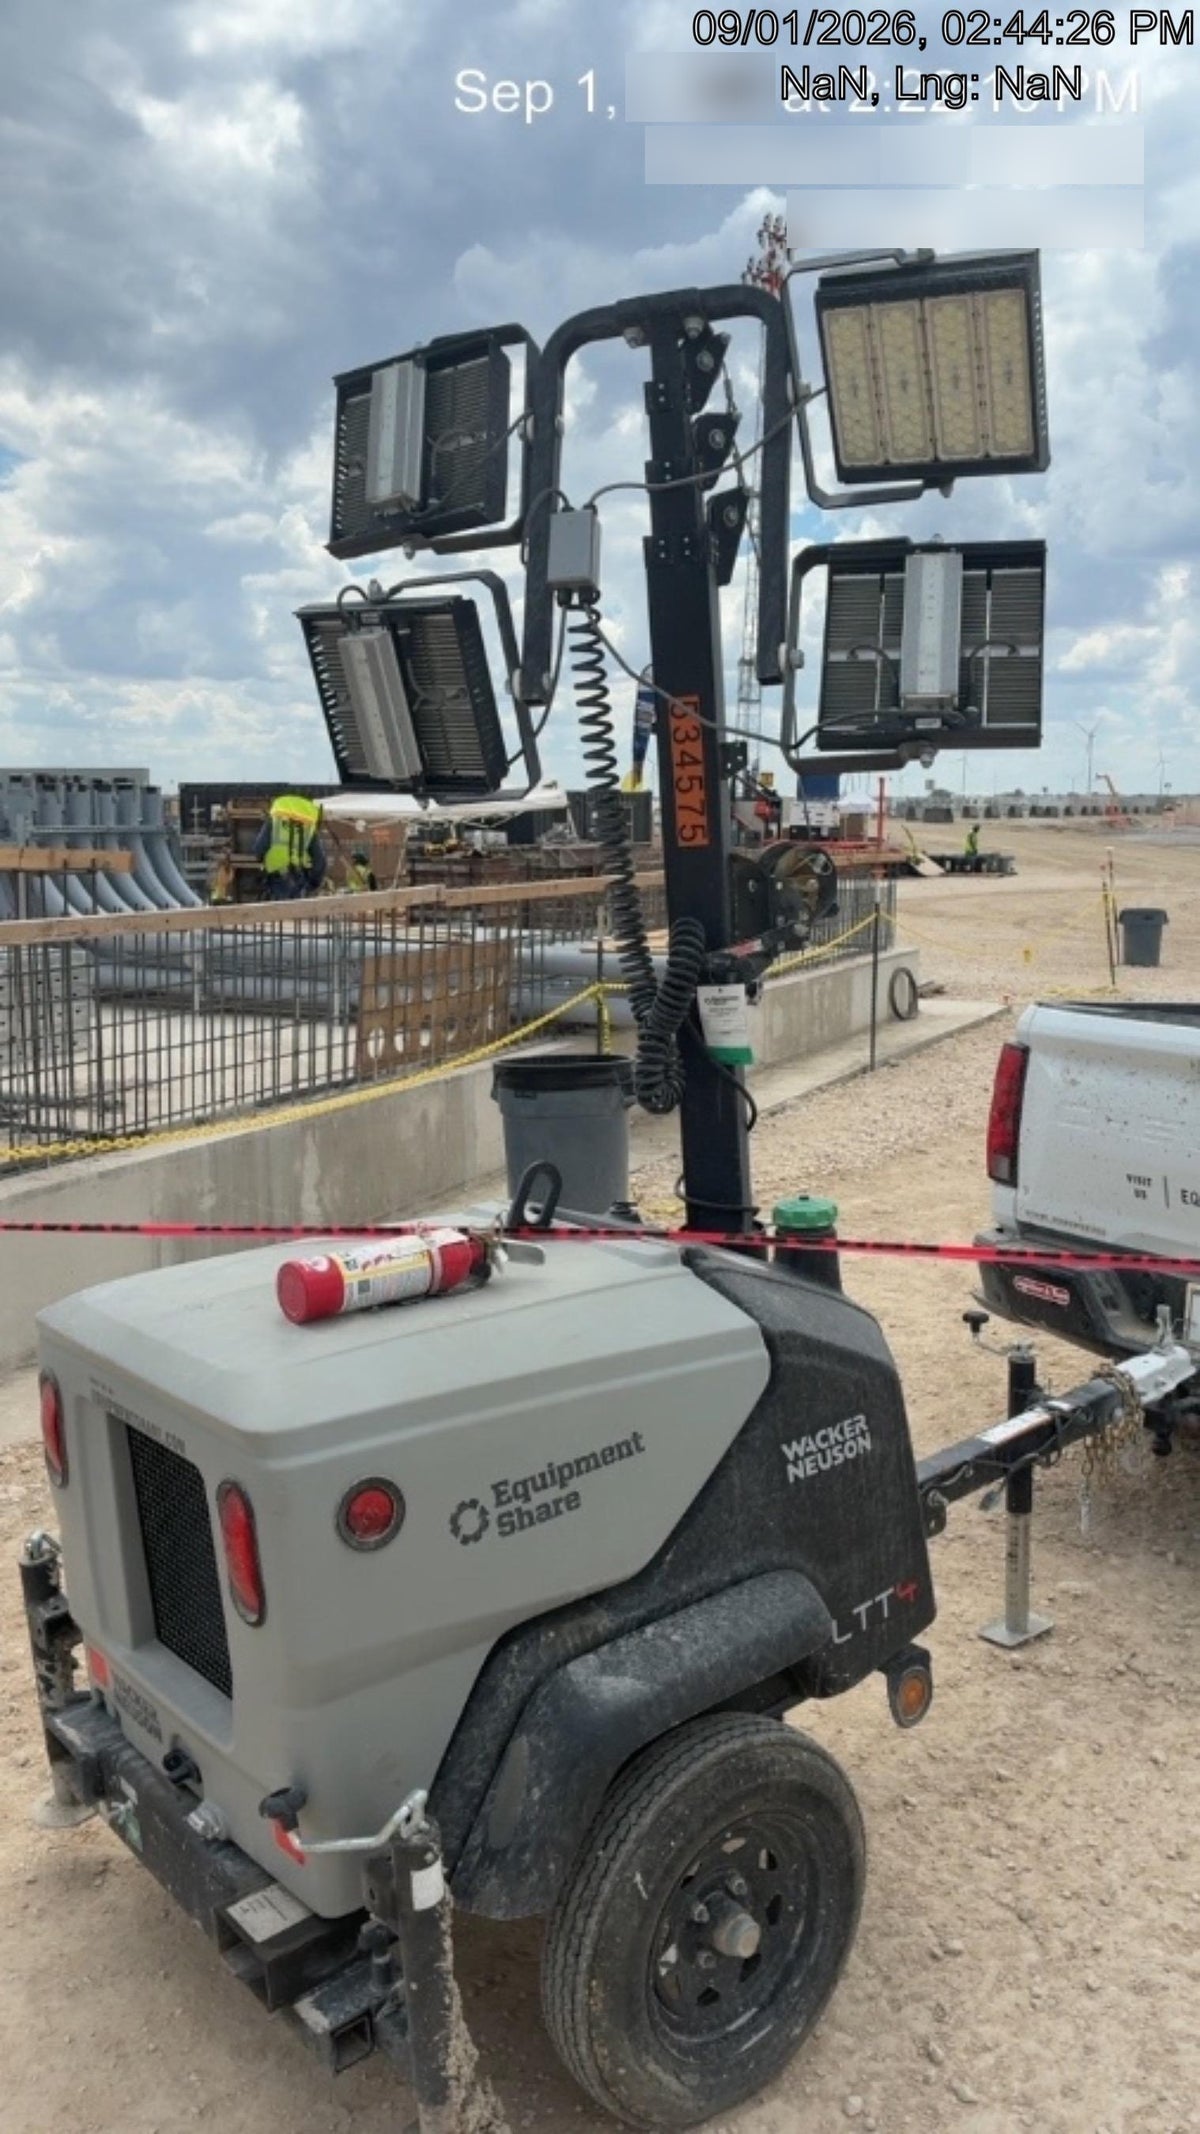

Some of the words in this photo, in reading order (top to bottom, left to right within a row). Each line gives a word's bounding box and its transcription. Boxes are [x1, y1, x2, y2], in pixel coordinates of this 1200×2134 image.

[781, 1413, 868, 1461] WACKER
[787, 1431, 871, 1484] NEUSON
[491, 1431, 646, 1508] Equipment
[496, 1490, 582, 1538] Share
